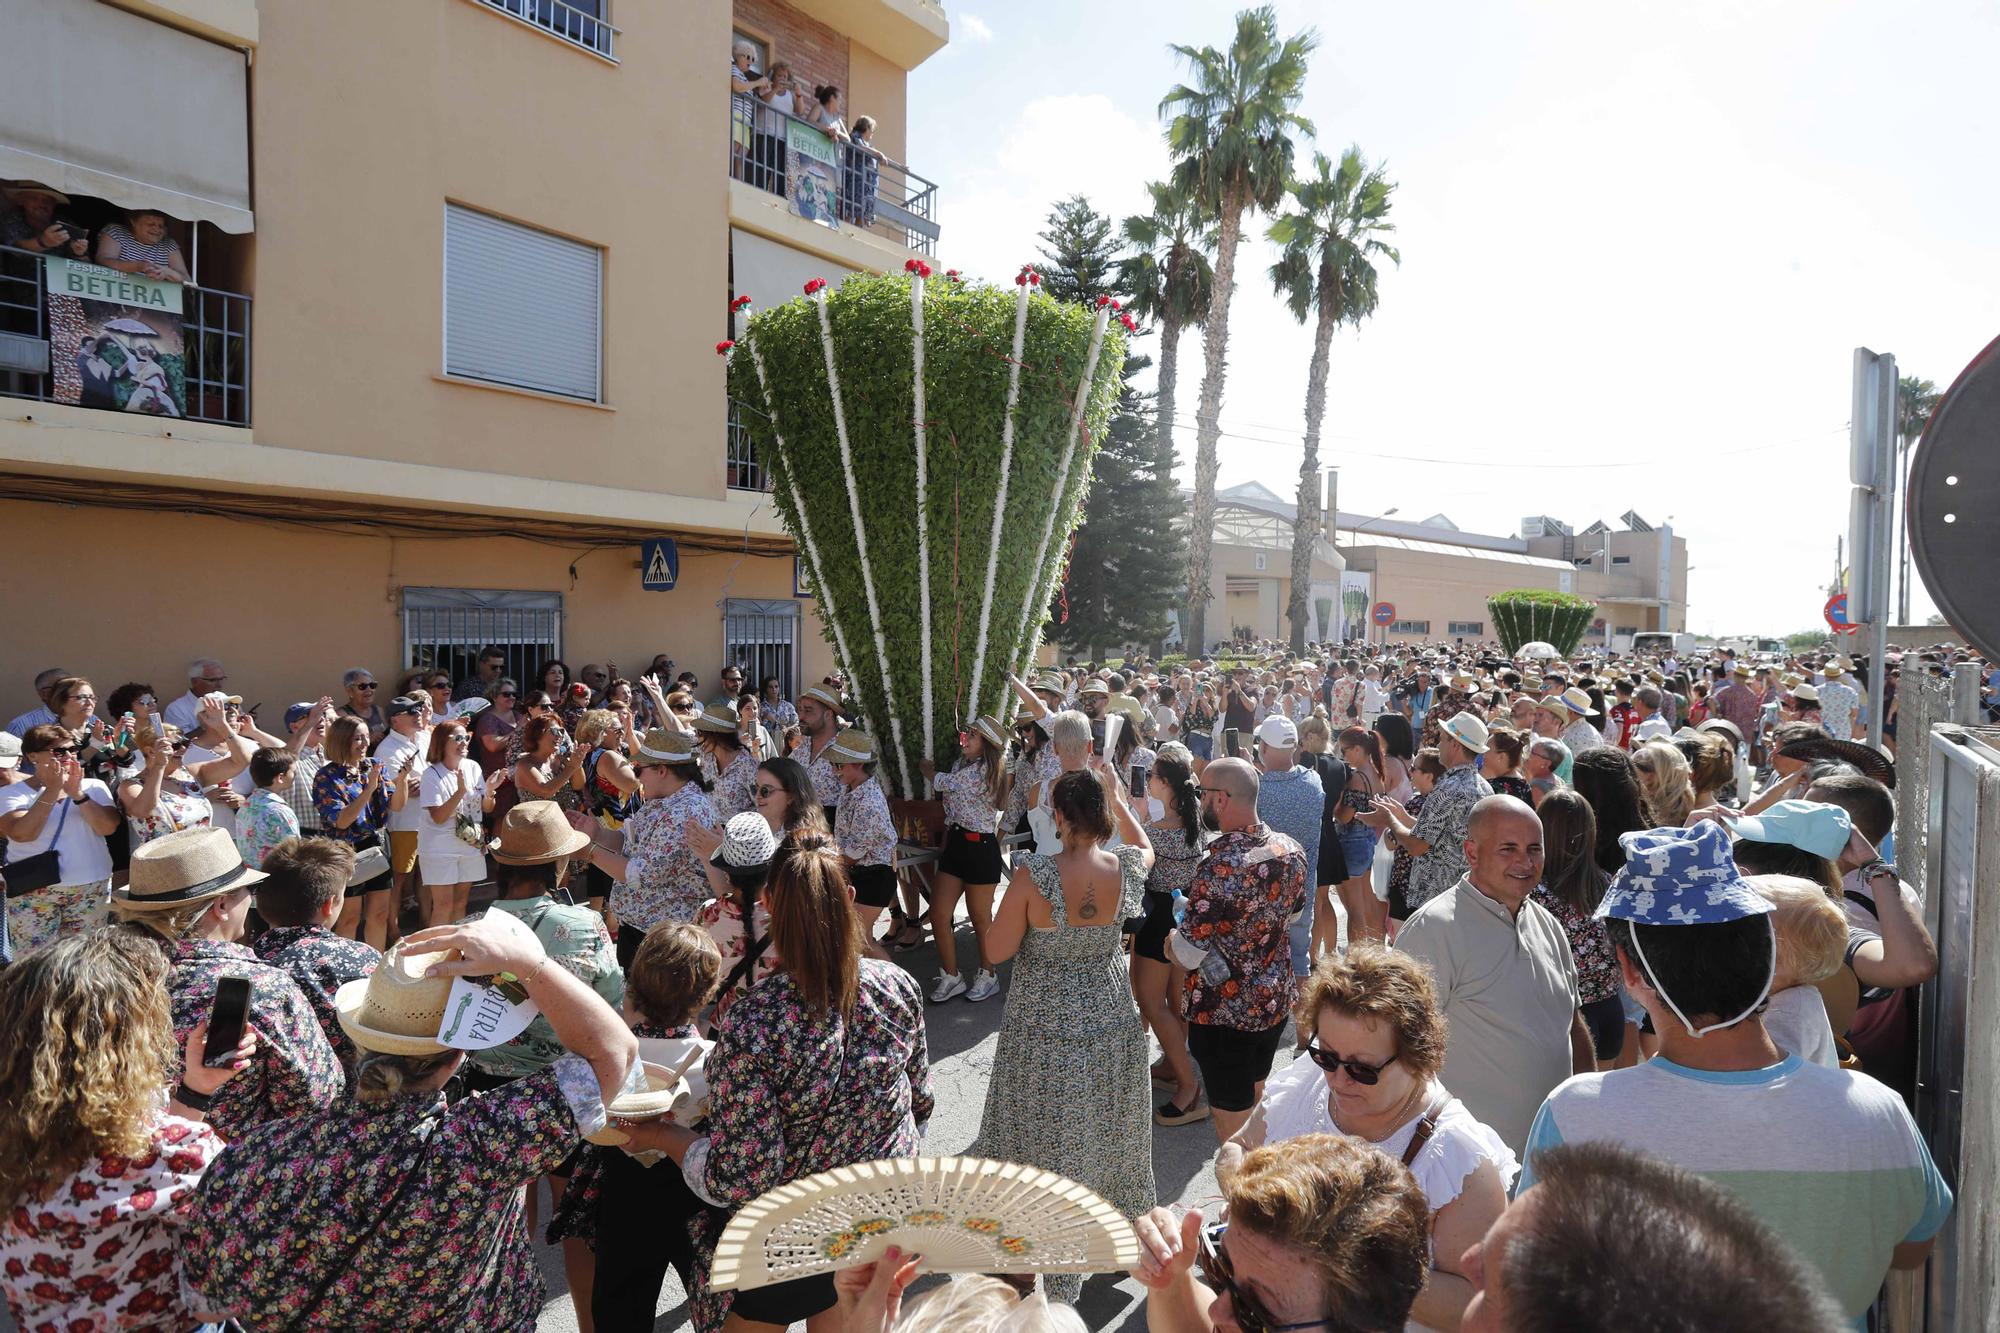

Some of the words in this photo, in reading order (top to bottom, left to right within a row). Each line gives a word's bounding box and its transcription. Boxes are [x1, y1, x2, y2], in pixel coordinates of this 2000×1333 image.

[793, 137, 830, 160] BETERA
[67, 259, 109, 276] Festes
[67, 273, 166, 306] BETERA
[468, 988, 508, 1043] BÉTERA
